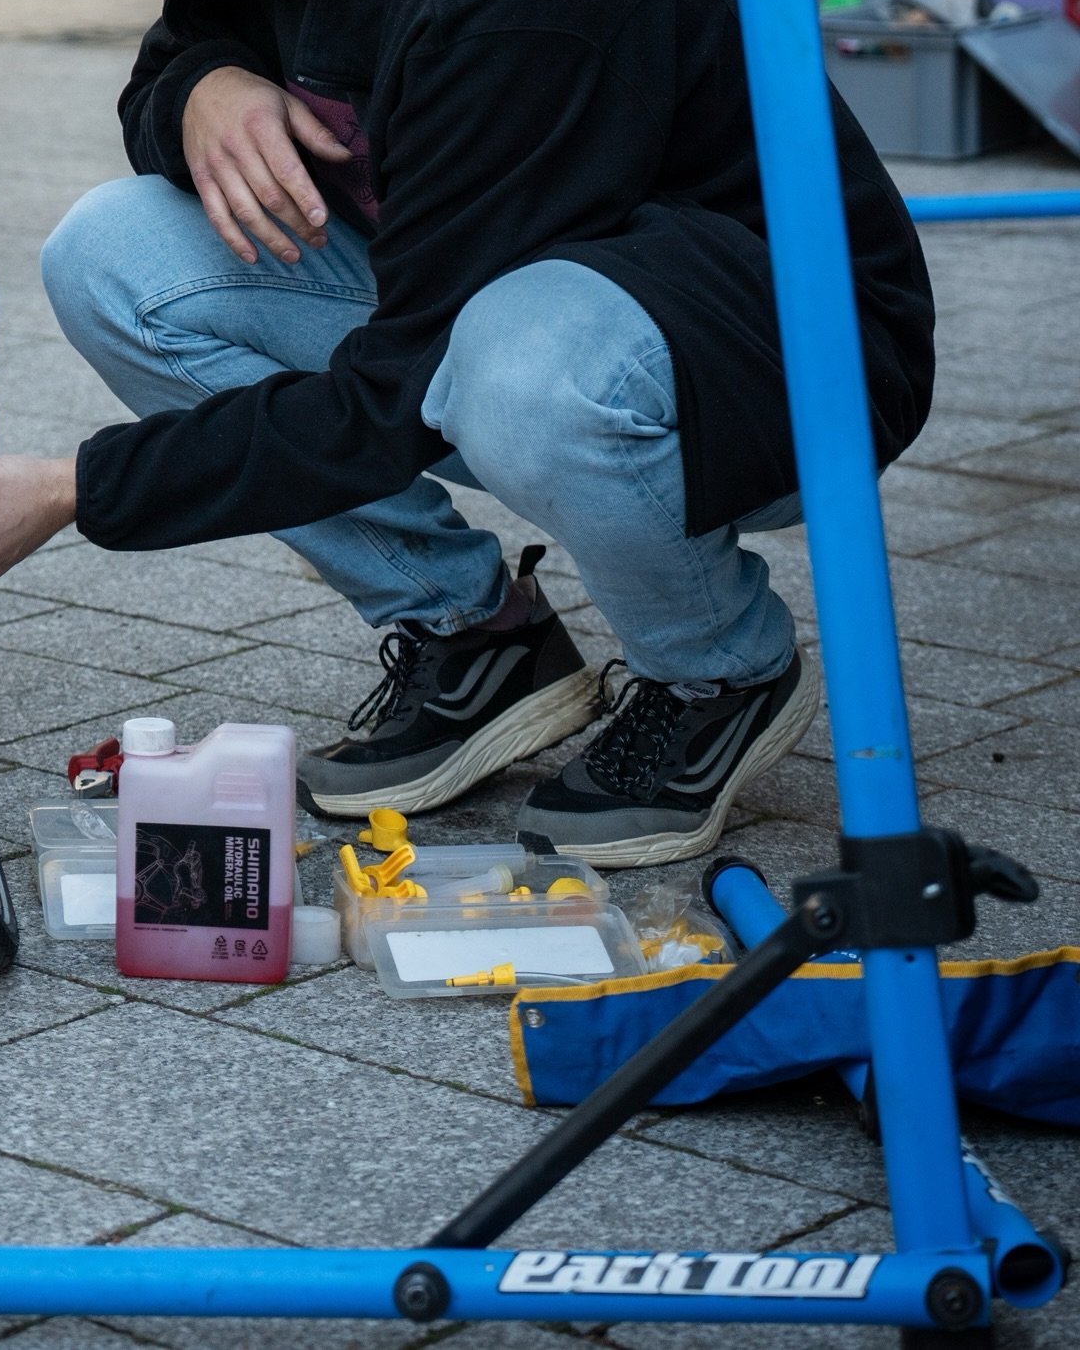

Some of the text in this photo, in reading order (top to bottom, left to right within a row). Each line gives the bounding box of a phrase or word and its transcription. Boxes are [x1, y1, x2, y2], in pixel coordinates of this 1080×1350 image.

[224, 836, 234, 883] MINERAL
[233, 837, 244, 899] HYDRAULIC
[246, 838, 260, 919] SHIMANO
[224, 886, 233, 903] OIL
